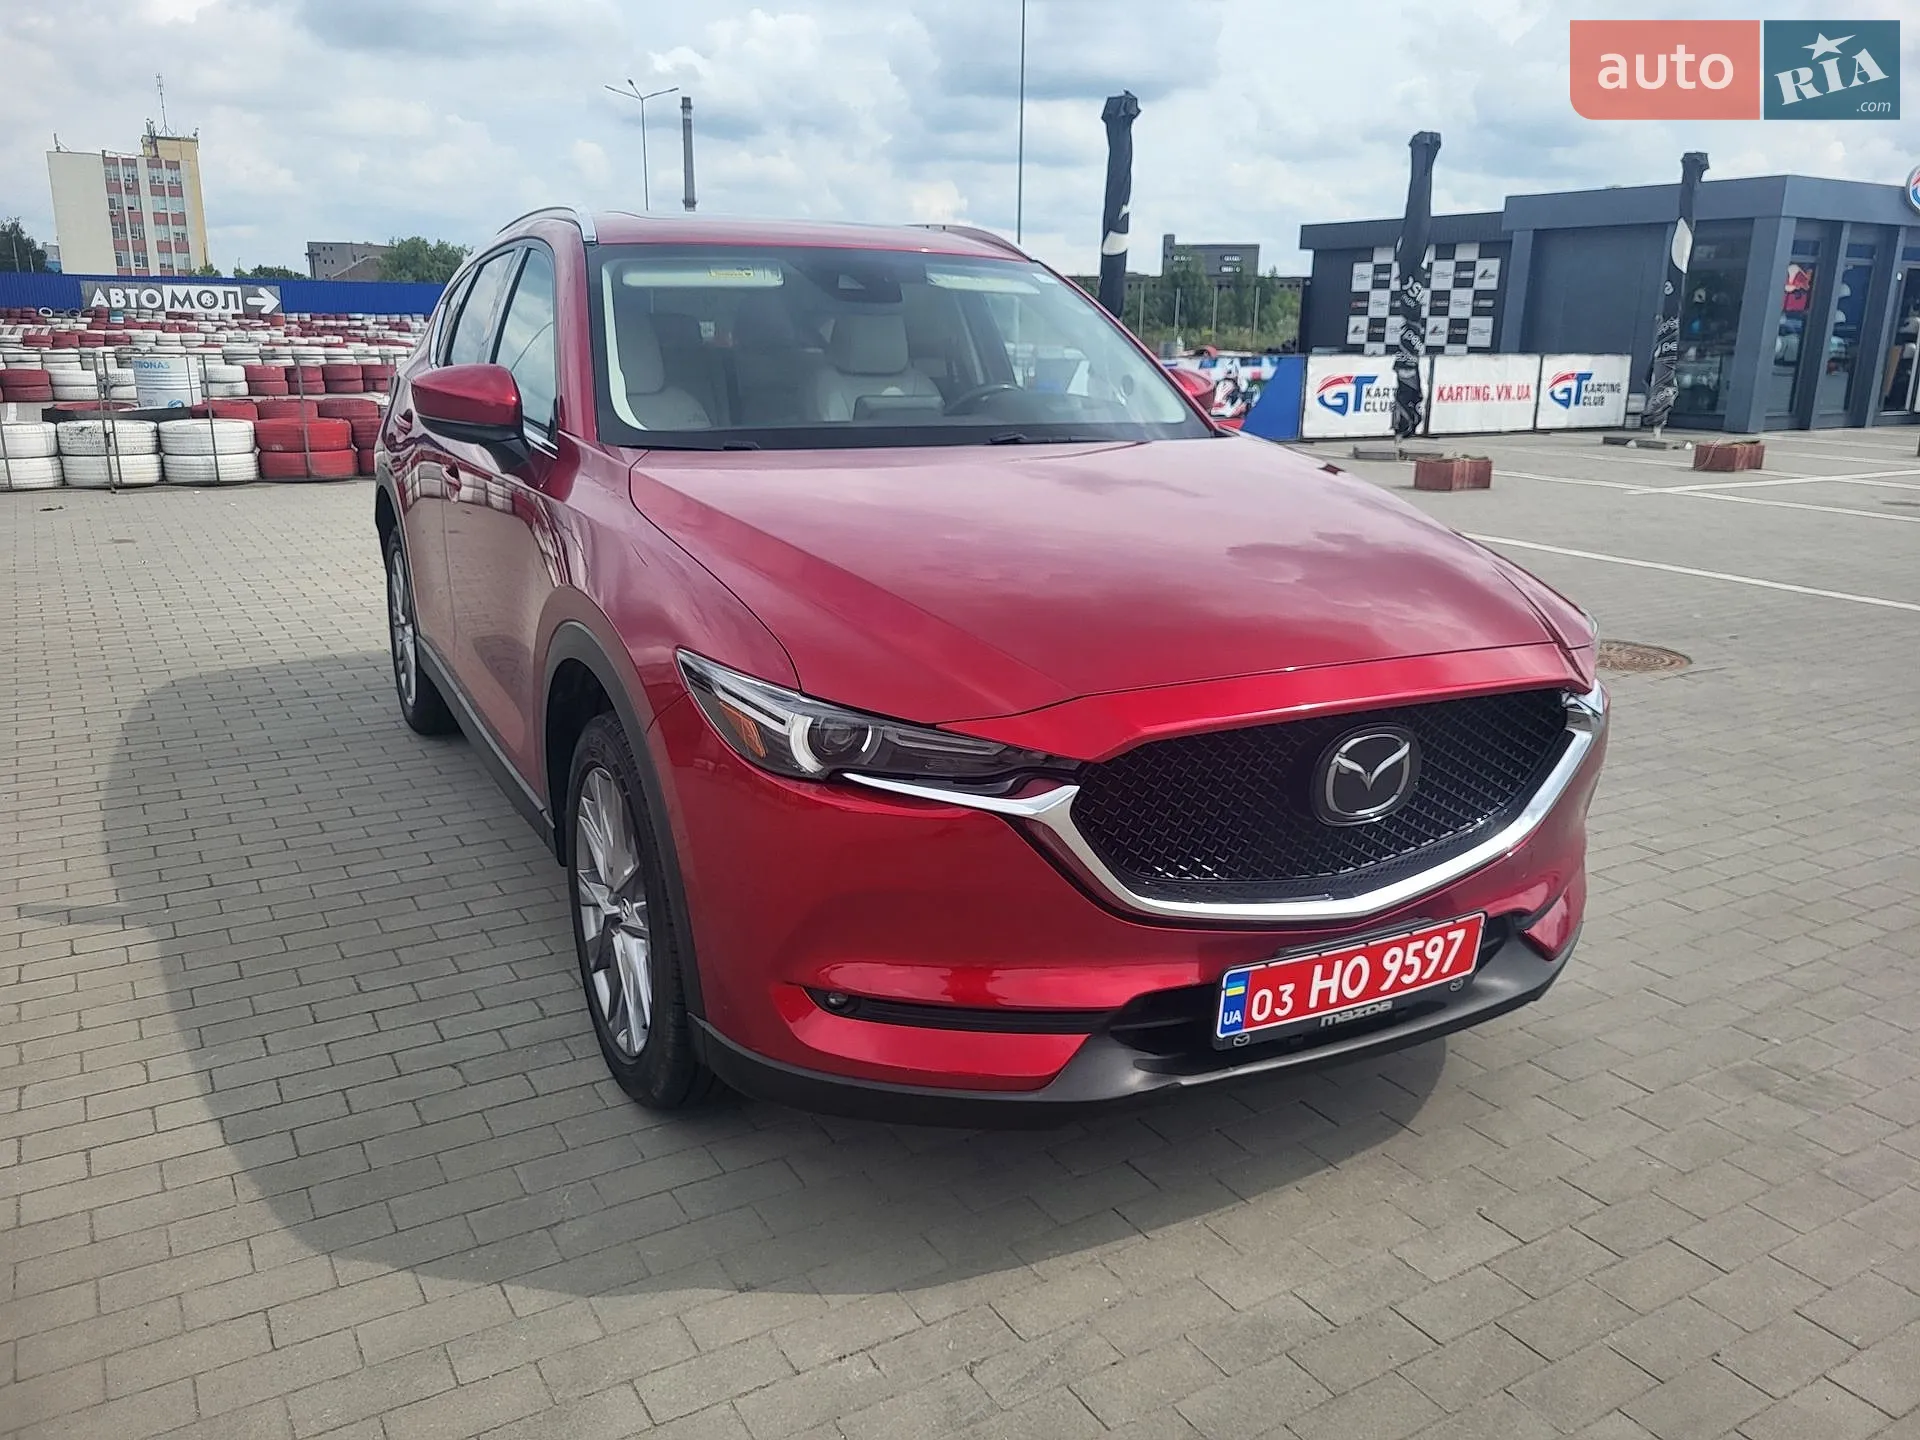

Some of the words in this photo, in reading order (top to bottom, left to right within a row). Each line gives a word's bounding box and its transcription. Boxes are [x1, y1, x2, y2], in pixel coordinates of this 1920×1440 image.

[1317, 374, 1378, 416] GT
[1437, 384, 1531, 403] KARTING.VN.UA
[1548, 372, 1593, 409] GT
[1250, 983, 1295, 1022] 03
[1308, 955, 1370, 1009] HO
[1380, 928, 1466, 992] 9597
[1223, 1009, 1242, 1025] UA
